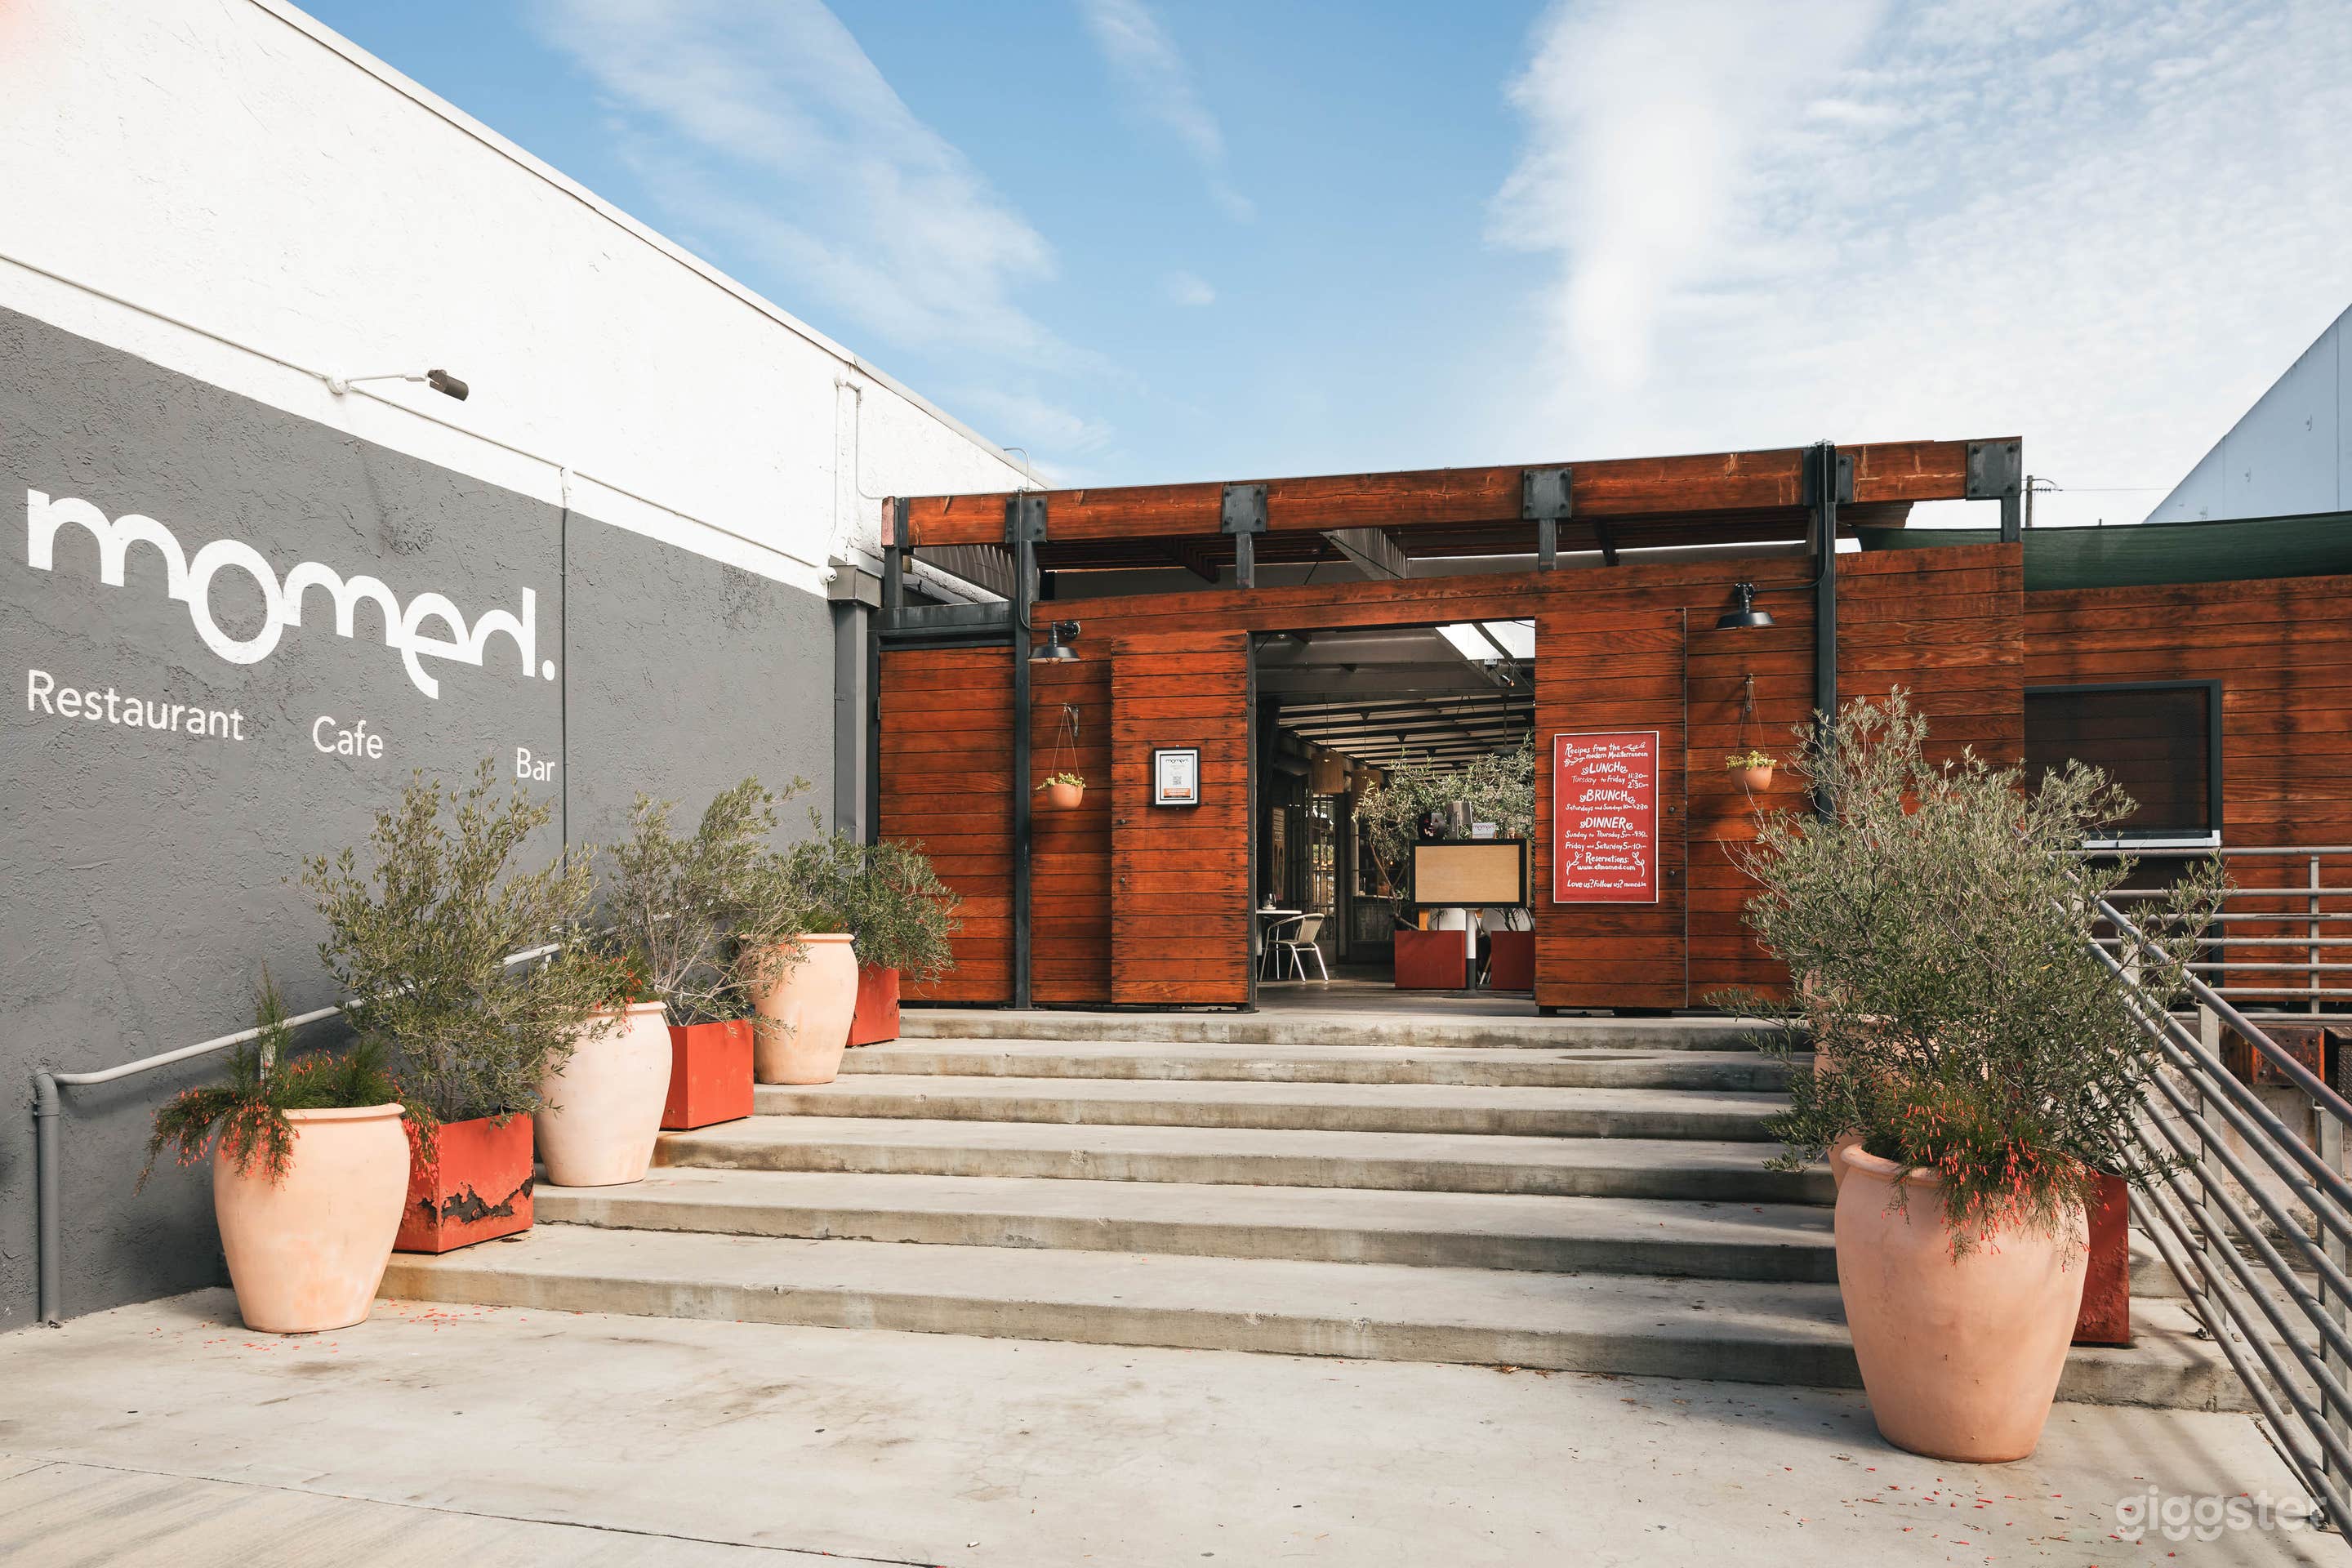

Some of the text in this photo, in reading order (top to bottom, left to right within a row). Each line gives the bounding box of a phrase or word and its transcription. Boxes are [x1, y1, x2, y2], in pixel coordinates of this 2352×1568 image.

[28, 669, 555, 782] Restaurant Cafe Bar
[1565, 743, 1590, 757] Recipes
[1609, 742, 1620, 751] the
[1608, 751, 1648, 759] Mediterranean
[1589, 761, 1620, 773] LUNCH
[1571, 775, 1597, 785] Tuesday
[1607, 775, 1625, 784] Friday
[1586, 789, 1628, 802] BRUNCH
[1566, 804, 1593, 813] Saturdays
[1603, 804, 1622, 812] Sundays
[1586, 817, 1626, 830] DINNER
[1565, 830, 1588, 840] Sunday
[1597, 831, 1620, 839] Thursday
[1565, 842, 1584, 852] Friday
[1595, 841, 1622, 853] Saturday
[1585, 852, 1629, 864] Reservations:
[1567, 880, 1583, 888] Love
[1583, 879, 1594, 889] us?
[1613, 880, 1624, 888] us?
